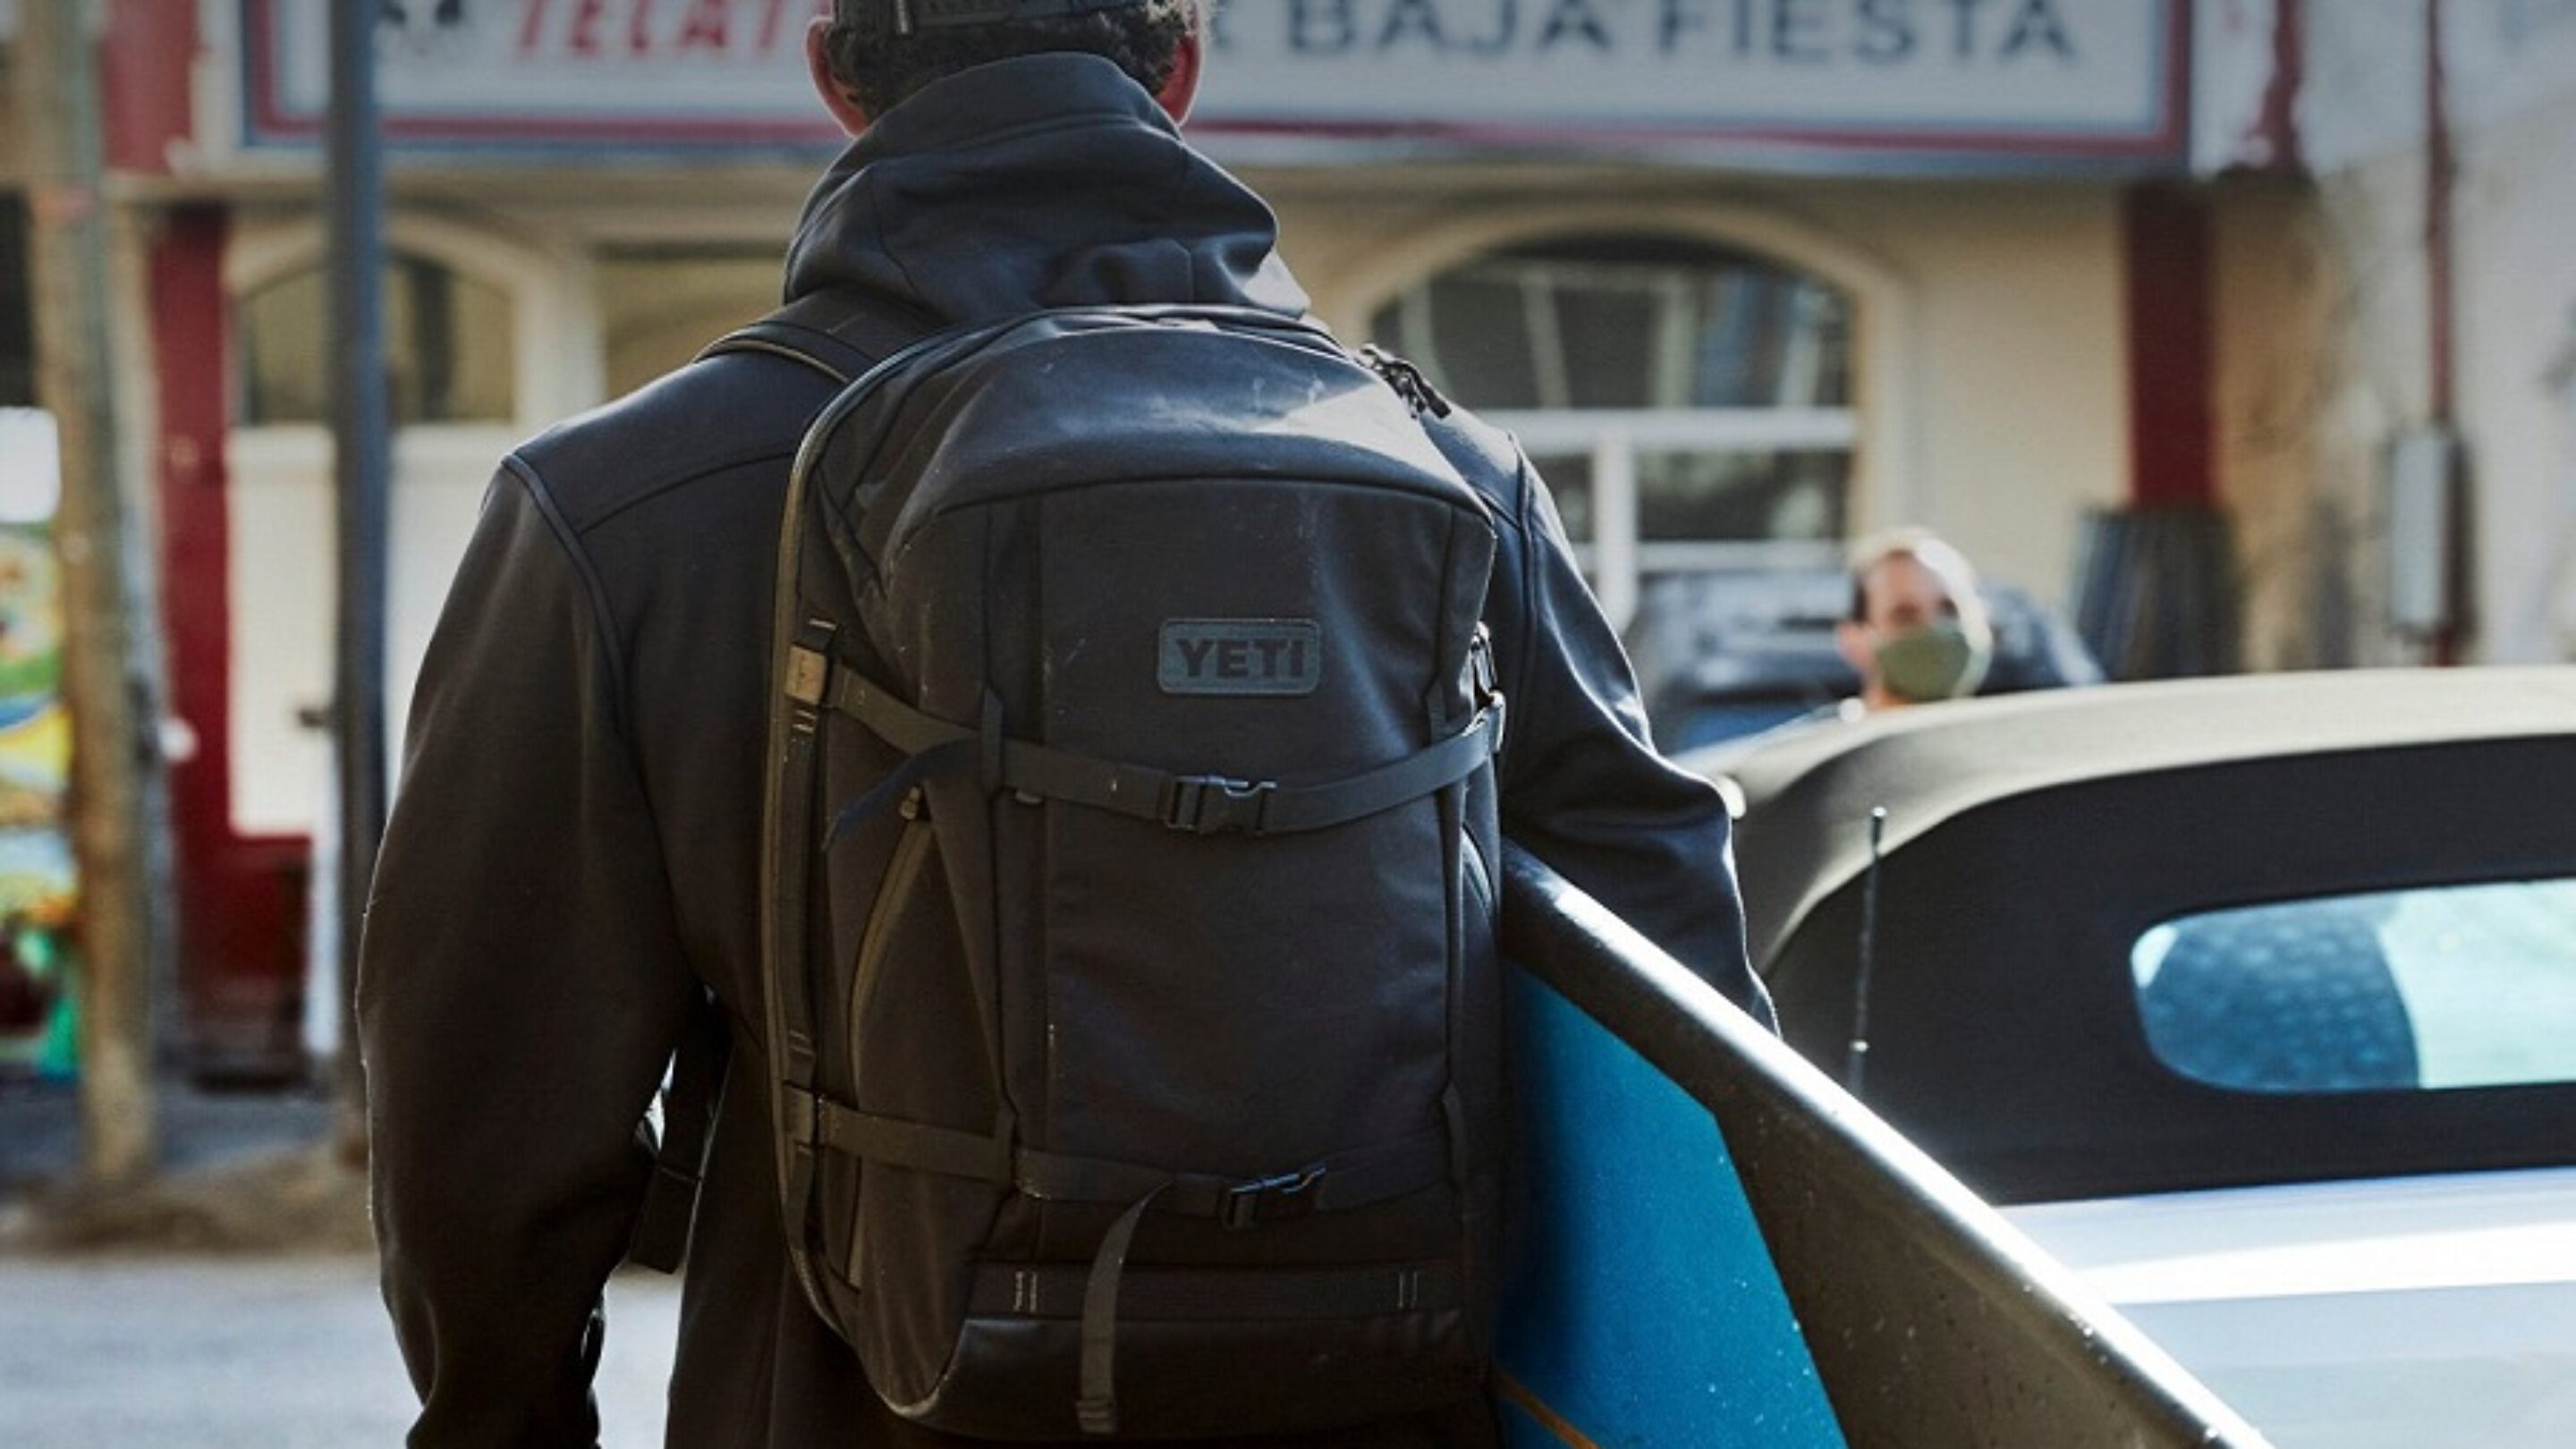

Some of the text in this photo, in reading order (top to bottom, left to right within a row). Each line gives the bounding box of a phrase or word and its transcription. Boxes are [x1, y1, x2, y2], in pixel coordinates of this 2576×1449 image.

[1286, 0, 1610, 55] BAJA
[1656, 0, 2077, 62] FIESTA
[1175, 638, 1304, 680] YETI
